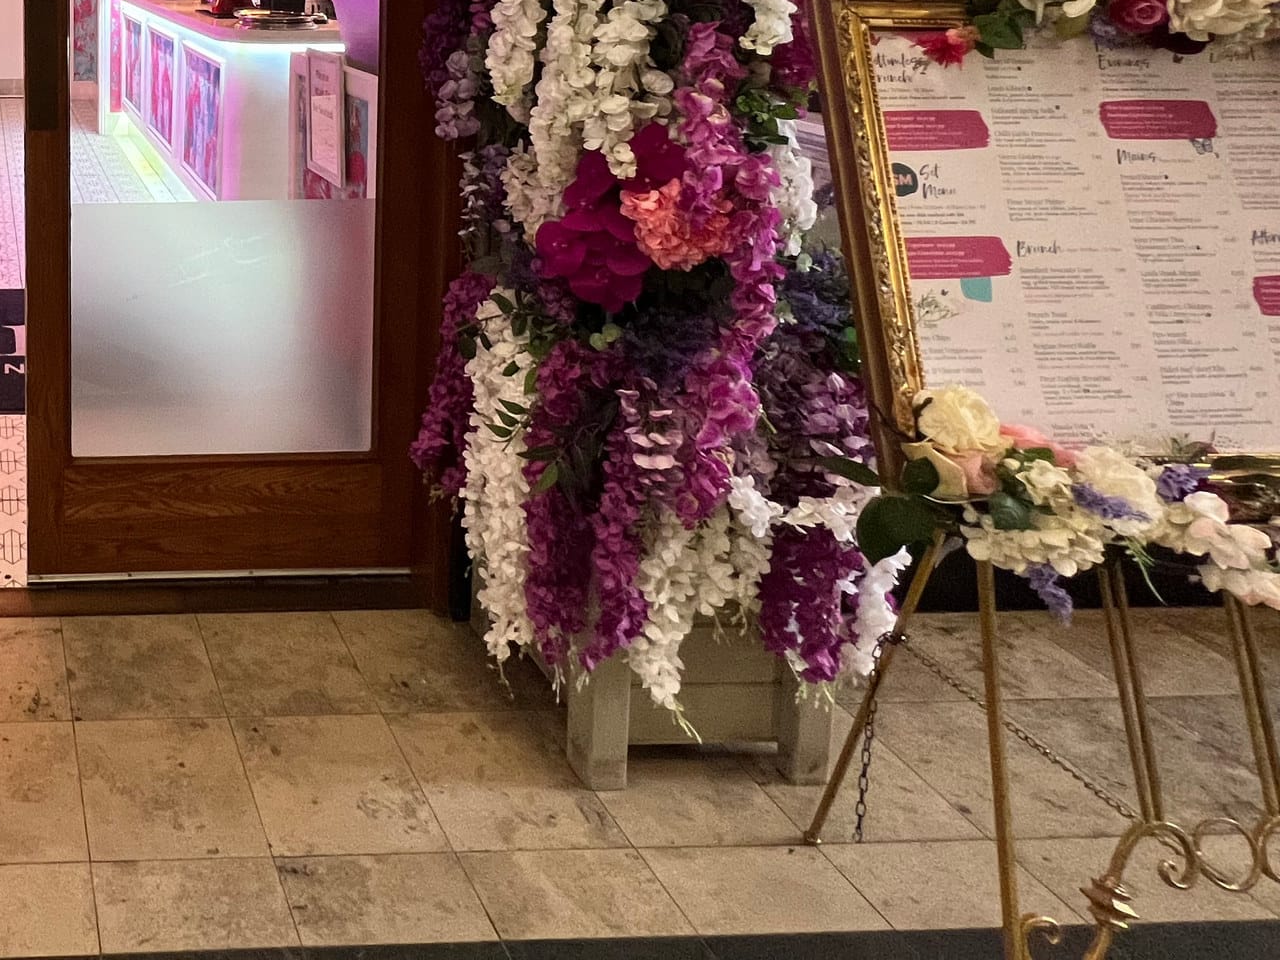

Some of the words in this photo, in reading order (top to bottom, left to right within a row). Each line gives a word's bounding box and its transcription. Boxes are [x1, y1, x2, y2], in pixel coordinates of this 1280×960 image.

[919, 163, 941, 180] Set
[922, 183, 957, 199] Menu
[1017, 240, 1061, 257] Brunch
